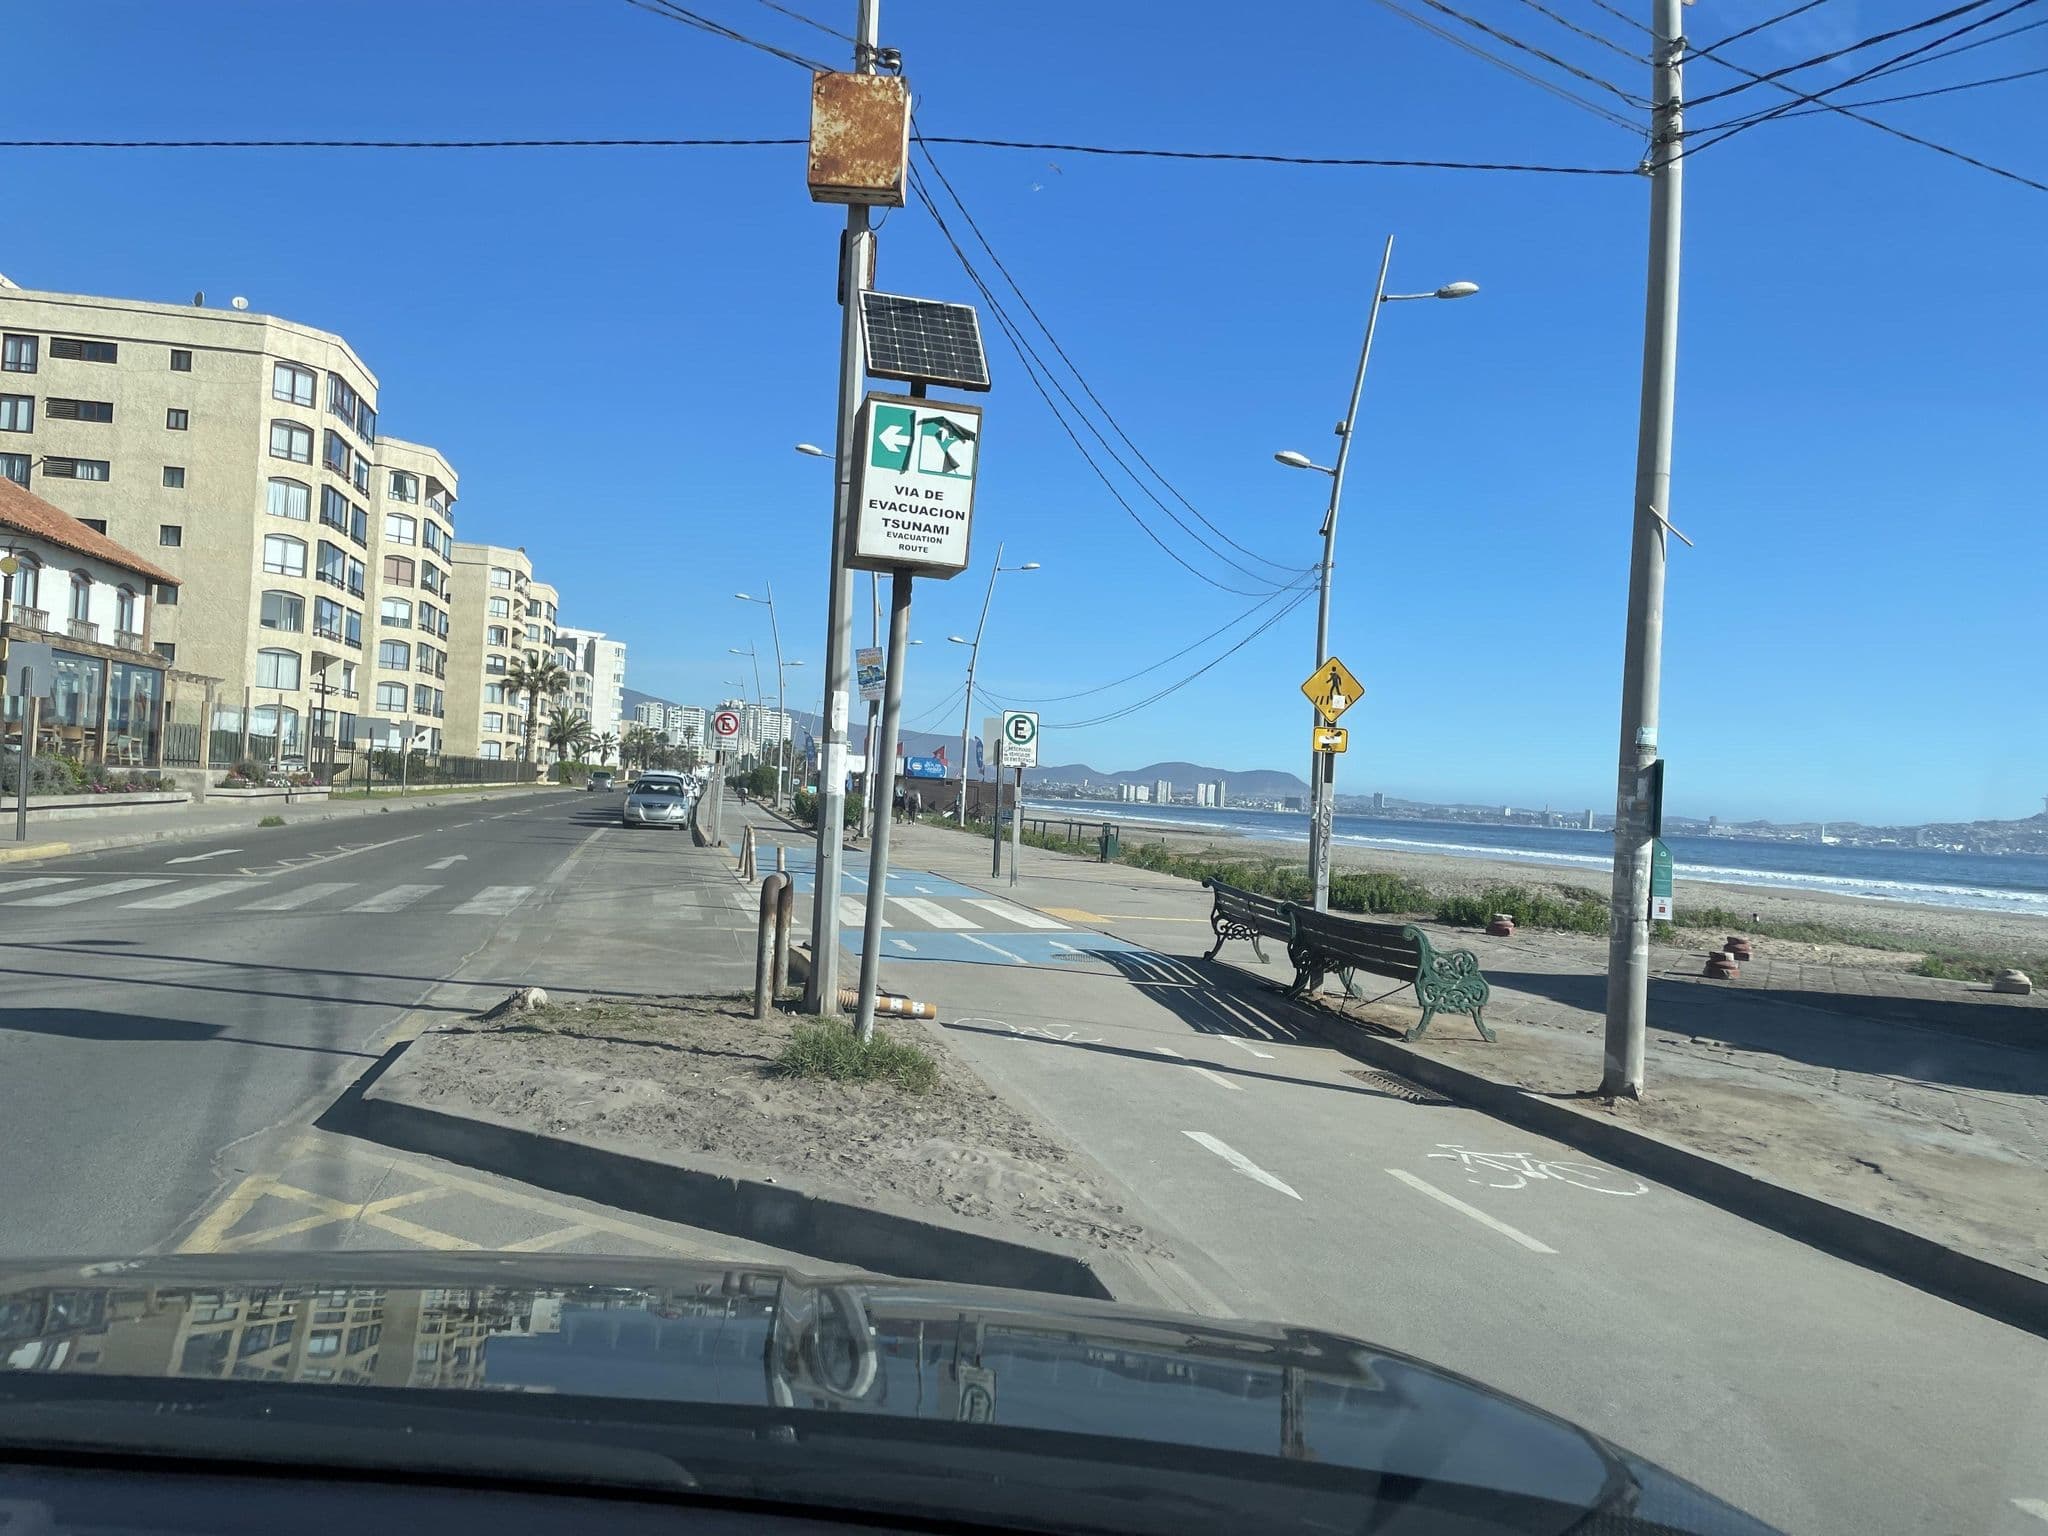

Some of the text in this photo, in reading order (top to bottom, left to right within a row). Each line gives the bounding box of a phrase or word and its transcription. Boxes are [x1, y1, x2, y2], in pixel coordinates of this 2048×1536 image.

[894, 486, 944, 500] VIA DE
[869, 499, 965, 520] EVACUACION
[882, 518, 949, 535] TSUNAMI
[886, 531, 943, 545] EVACUATION
[899, 544, 928, 553] ROUTE
[1015, 720, 1026, 739] E
